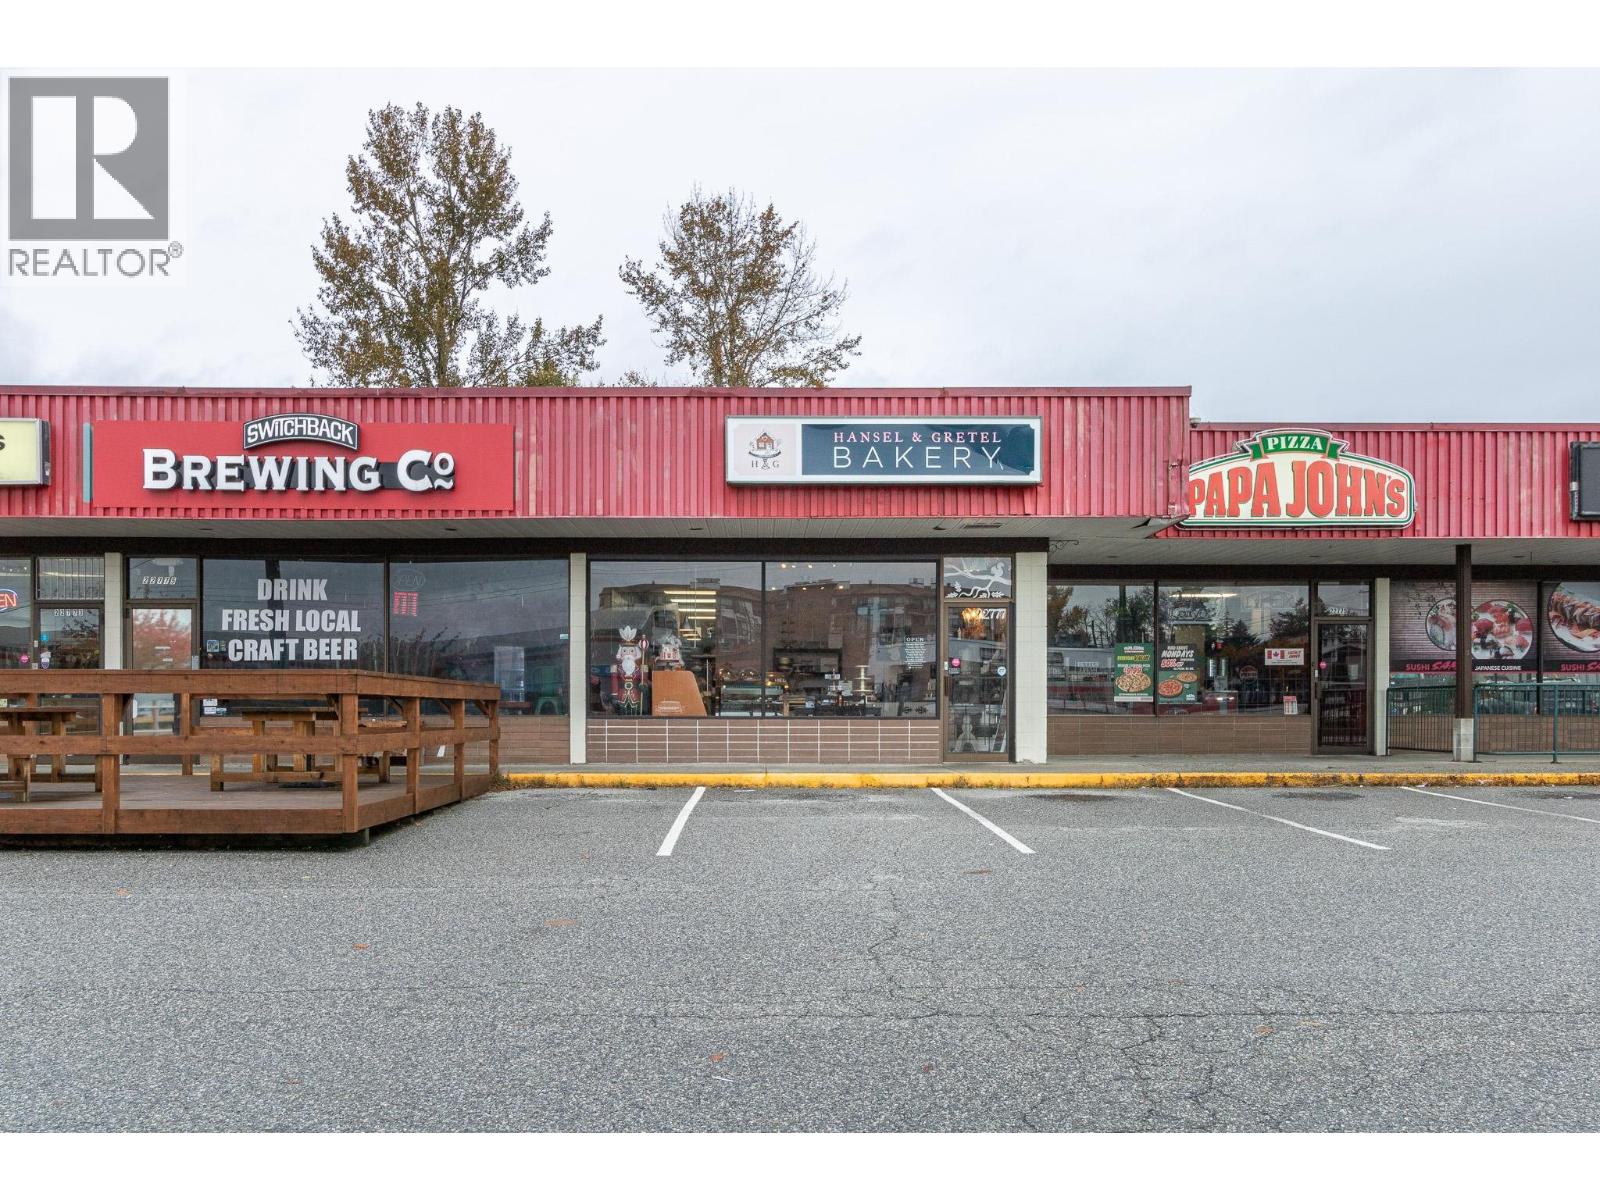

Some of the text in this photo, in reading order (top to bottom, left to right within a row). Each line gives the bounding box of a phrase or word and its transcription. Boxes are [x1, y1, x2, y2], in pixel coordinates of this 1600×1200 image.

[833, 431, 1002, 443] HANSEL & GRETEL
[1267, 436, 1323, 450] PIZZA
[833, 446, 1004, 470] BAKERY
[1189, 461, 1281, 518] PAPA
[257, 578, 328, 601] DRINK
[221, 609, 361, 632] FRESH LOCAL
[228, 638, 299, 661] CRAFT
[303, 638, 357, 661] BEER
[1161, 650, 1194, 658] MONDAYS
[1406, 663, 1430, 671] SUSHI
[1560, 663, 1585, 671] SUSHI
